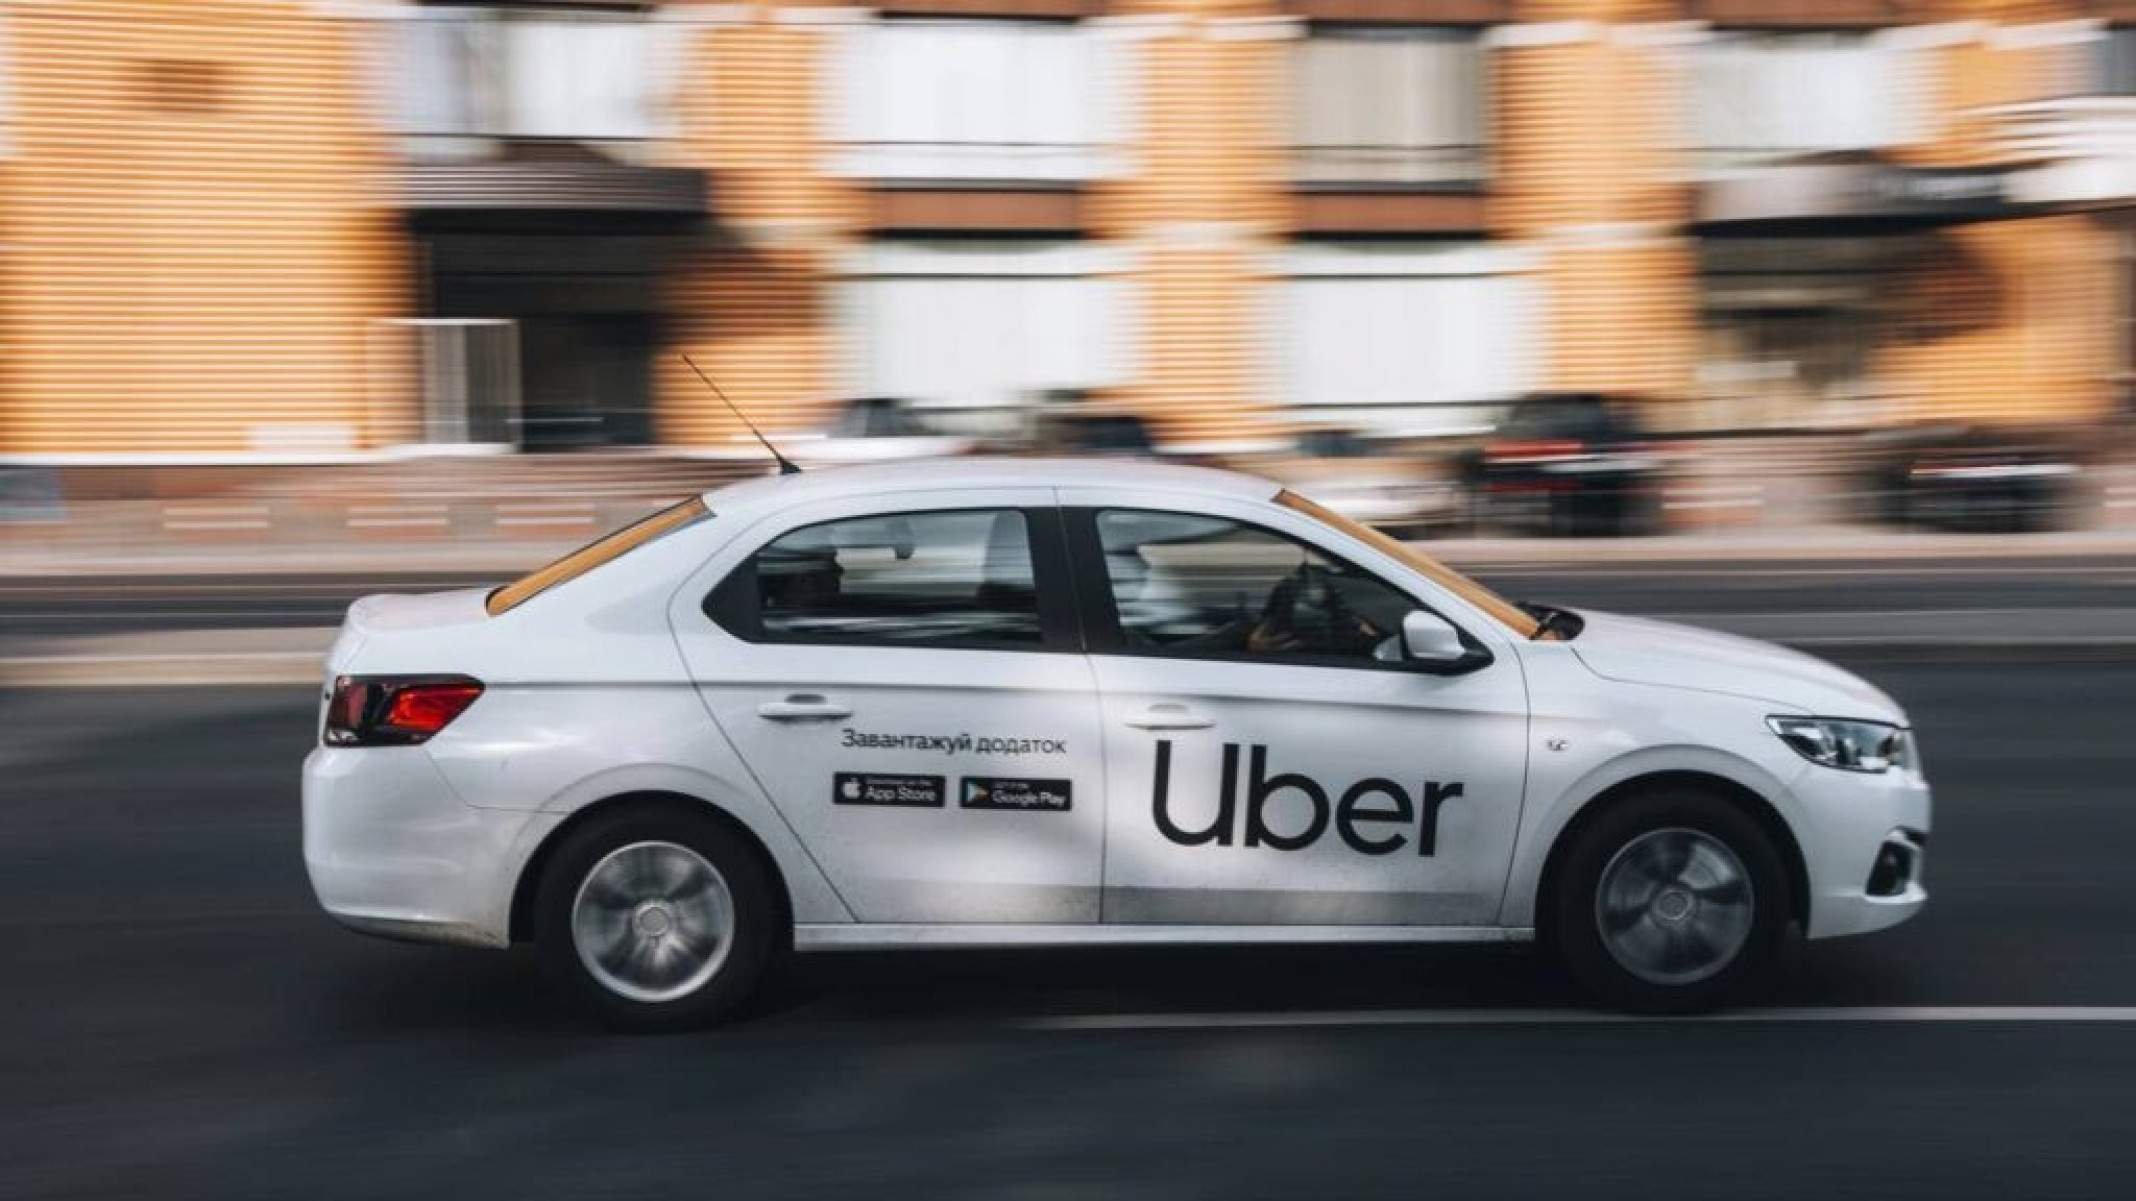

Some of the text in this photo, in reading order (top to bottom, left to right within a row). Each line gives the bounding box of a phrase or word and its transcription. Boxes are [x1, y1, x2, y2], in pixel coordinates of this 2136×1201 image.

[841, 727, 1067, 756] Завантажуй додаток
[864, 784, 937, 802] App Store
[992, 789, 1066, 808] Google Play
[1152, 739, 1465, 858] Uber
